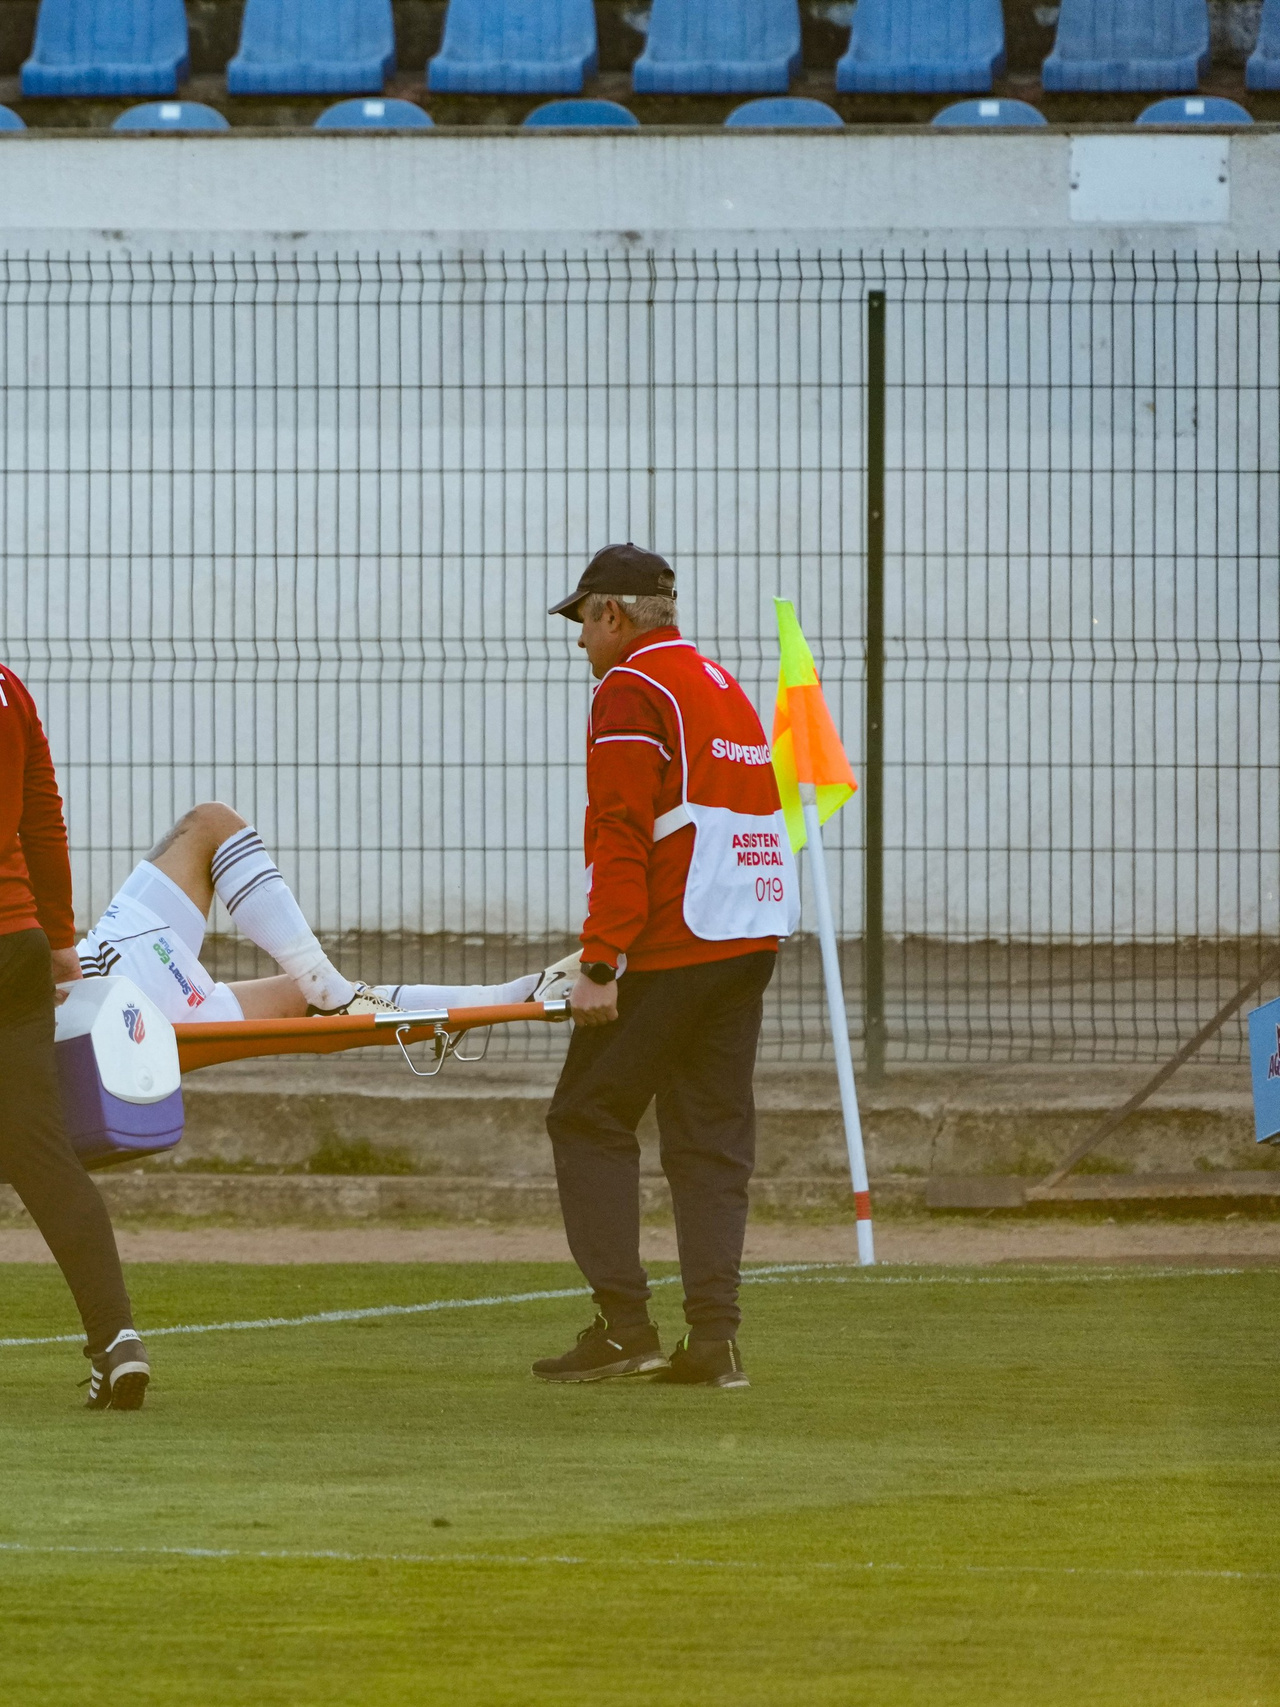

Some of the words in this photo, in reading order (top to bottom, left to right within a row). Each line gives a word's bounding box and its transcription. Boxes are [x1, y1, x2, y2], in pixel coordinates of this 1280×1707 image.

[737, 851, 784, 867] MEDICAL
[755, 877, 784, 902] 019
[168, 962, 192, 996] Smart
